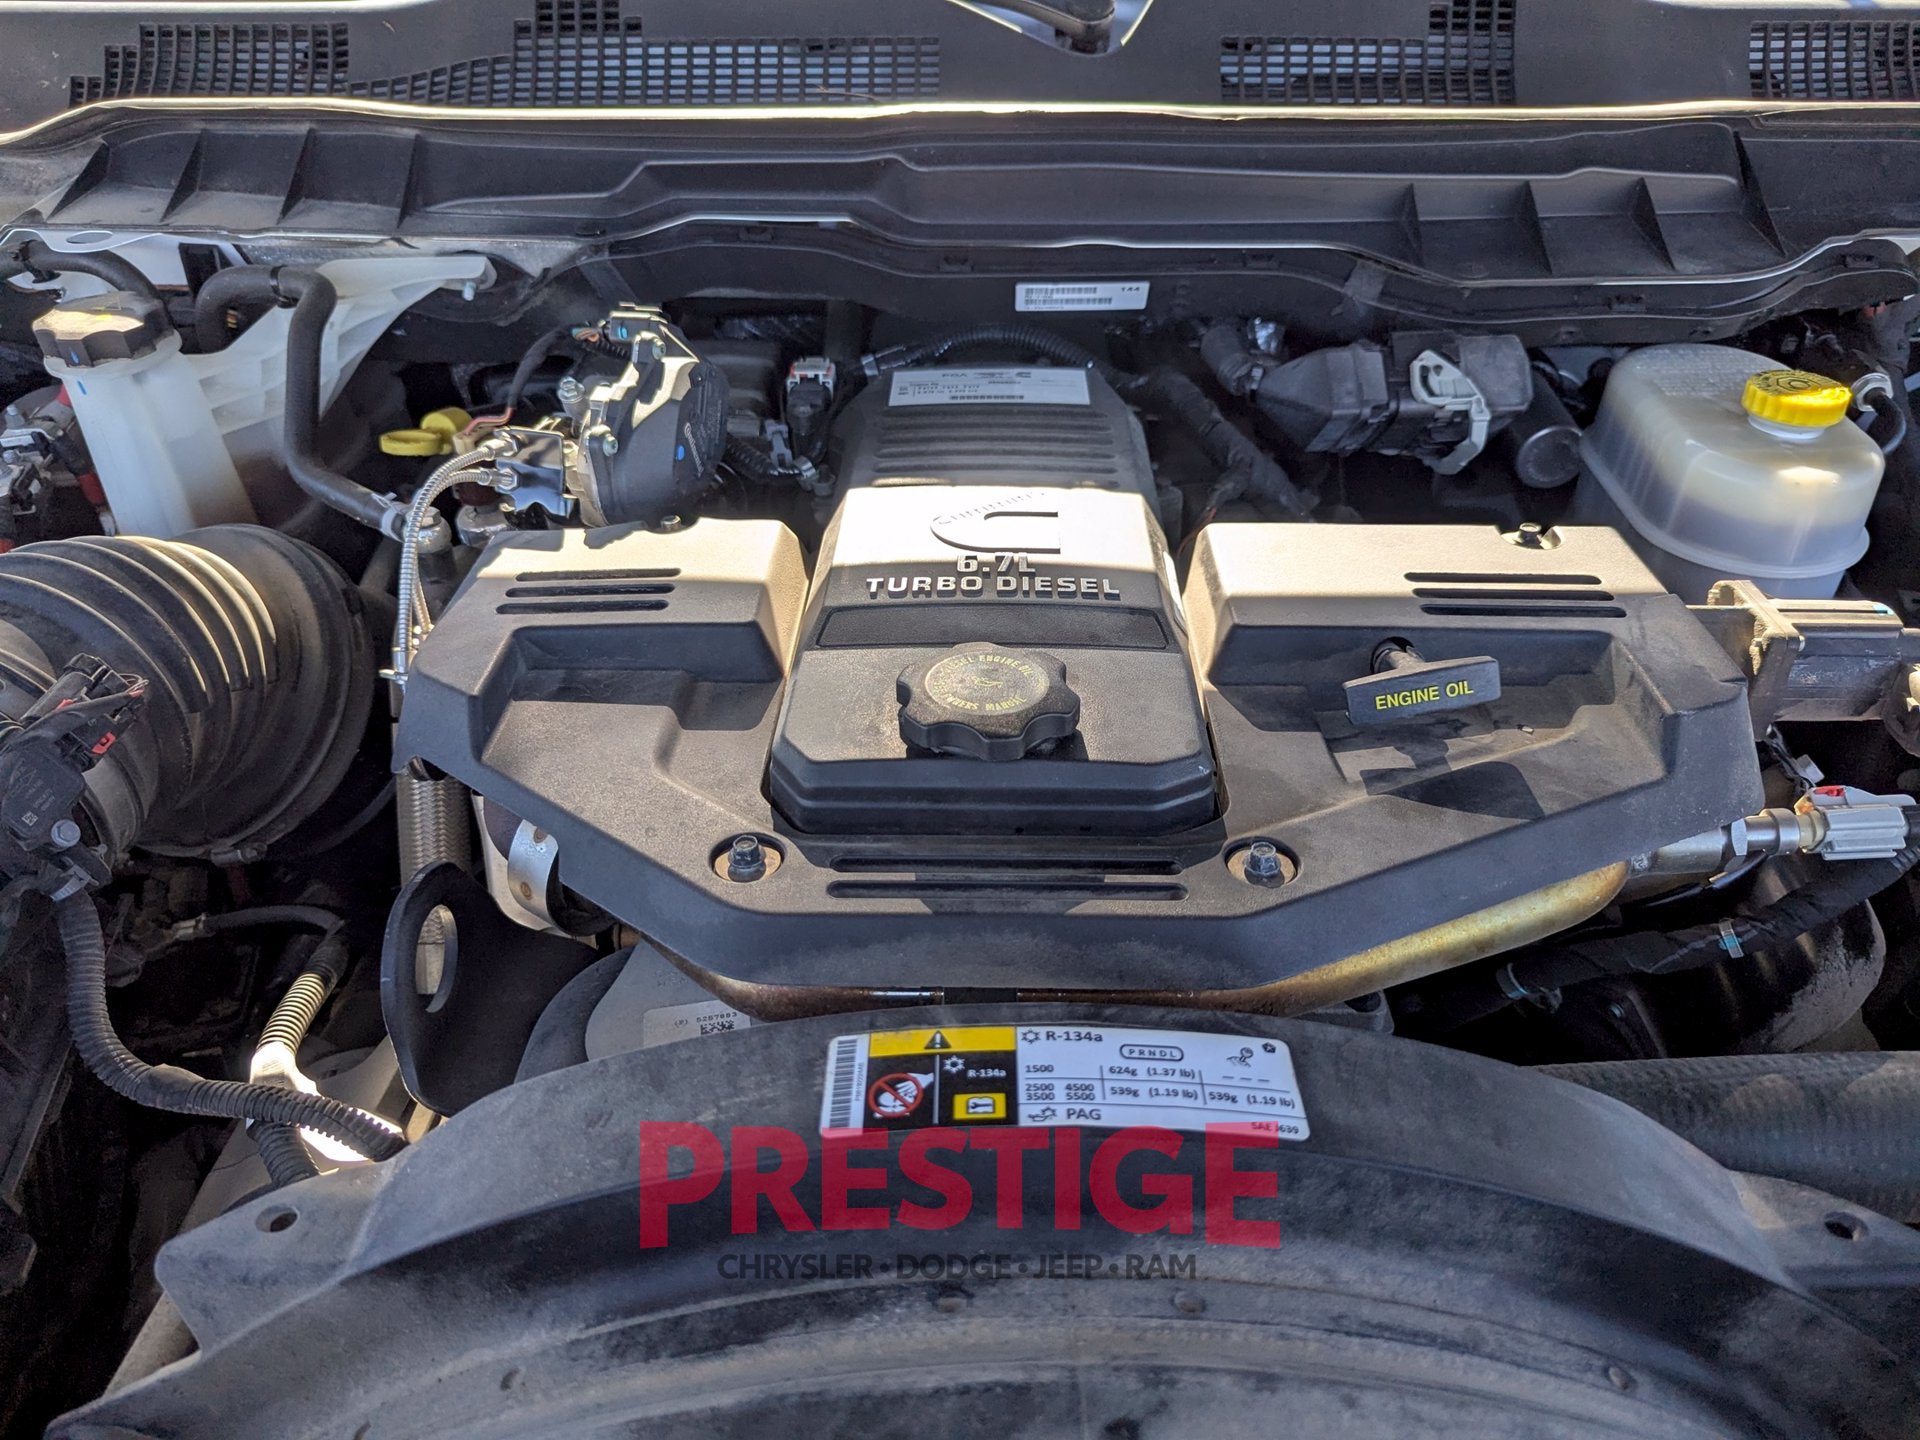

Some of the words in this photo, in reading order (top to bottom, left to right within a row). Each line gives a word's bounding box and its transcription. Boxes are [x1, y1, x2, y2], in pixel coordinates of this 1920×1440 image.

[957, 551, 1036, 573] 6.7L
[865, 575, 984, 595] TURBO
[996, 575, 1120, 596] DIESEL
[979, 655, 1021, 667] ENGINE
[1375, 686, 1440, 710] ENGINE
[1446, 680, 1474, 698] OIL
[1045, 1030, 1103, 1042] R-134a
[966, 1068, 1007, 1078] R-134a
[1025, 1064, 1055, 1073] 1500
[1109, 1065, 1138, 1077] 624g
[1146, 1066, 1177, 1077] (1.37
[1179, 1068, 1196, 1080] lb)
[1025, 1083, 1055, 1092] 2500
[1065, 1083, 1095, 1092] 4500
[1110, 1086, 1140, 1098] 539g
[1148, 1087, 1179, 1098] (1.19
[1181, 1089, 1199, 1101] lb)
[1208, 1091, 1239, 1104] 539g
[1246, 1093, 1278, 1106] (1.19
[1280, 1096, 1296, 1109] lb)
[1026, 1092, 1056, 1101] 3500
[1065, 1092, 1096, 1101] 5500
[1066, 1108, 1102, 1121] PAG
[1250, 1121, 1273, 1132] SAE
